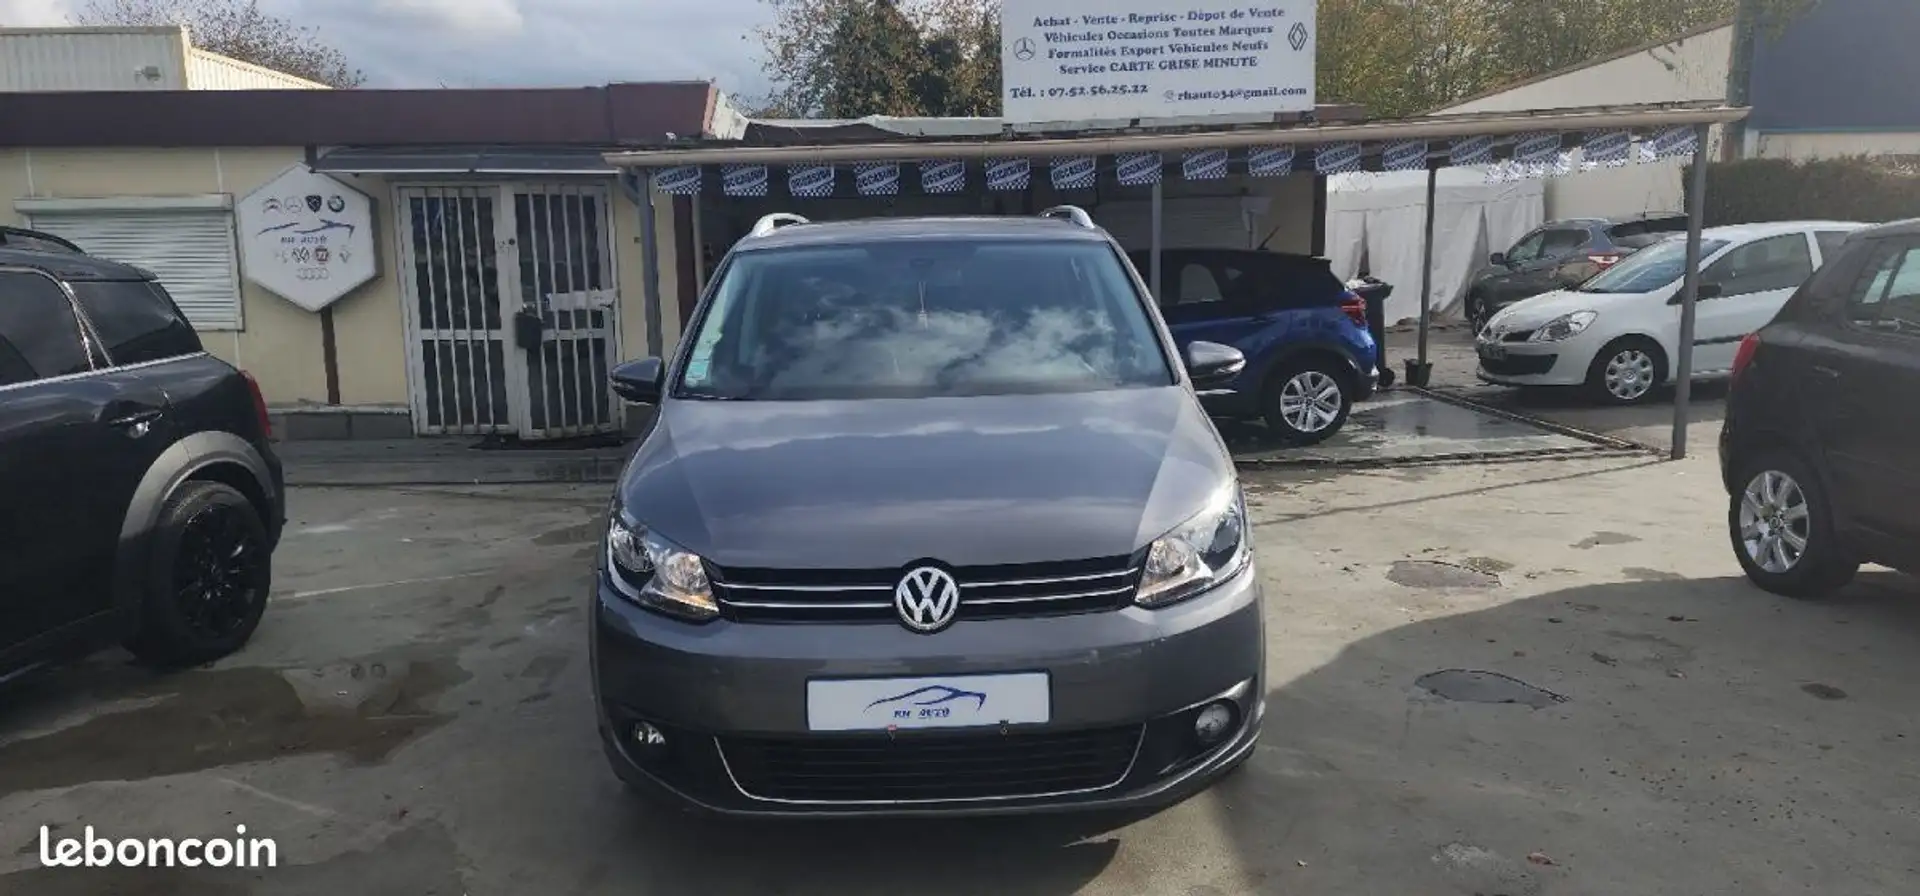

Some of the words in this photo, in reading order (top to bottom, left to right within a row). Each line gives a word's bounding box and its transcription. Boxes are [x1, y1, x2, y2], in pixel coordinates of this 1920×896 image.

[1033, 16, 1070, 27] Achat
[1082, 15, 1118, 25] Vente
[1128, 13, 1177, 24] Reprise
[1230, 9, 1246, 18] de
[1249, 7, 1285, 18] Vente
[1044, 31, 1104, 43] Véhicules
[1107, 28, 1169, 40] Occasions
[1173, 27, 1216, 38] Toutes
[1219, 25, 1274, 37] Marques
[1048, 47, 1117, 59] Formalités
[1120, 45, 1164, 57] Export
[1168, 41, 1229, 54] Véhicules
[1232, 40, 1269, 51] Neufs
[1059, 63, 1106, 75] Service
[1110, 61, 1155, 72] CARTE
[1158, 58, 1200, 70] GRISE
[1203, 56, 1258, 68] MINUTE
[857, 166, 898, 187] OCCASION
[1052, 159, 1094, 181] OCCASION
[917, 707, 950, 719] AUTO
